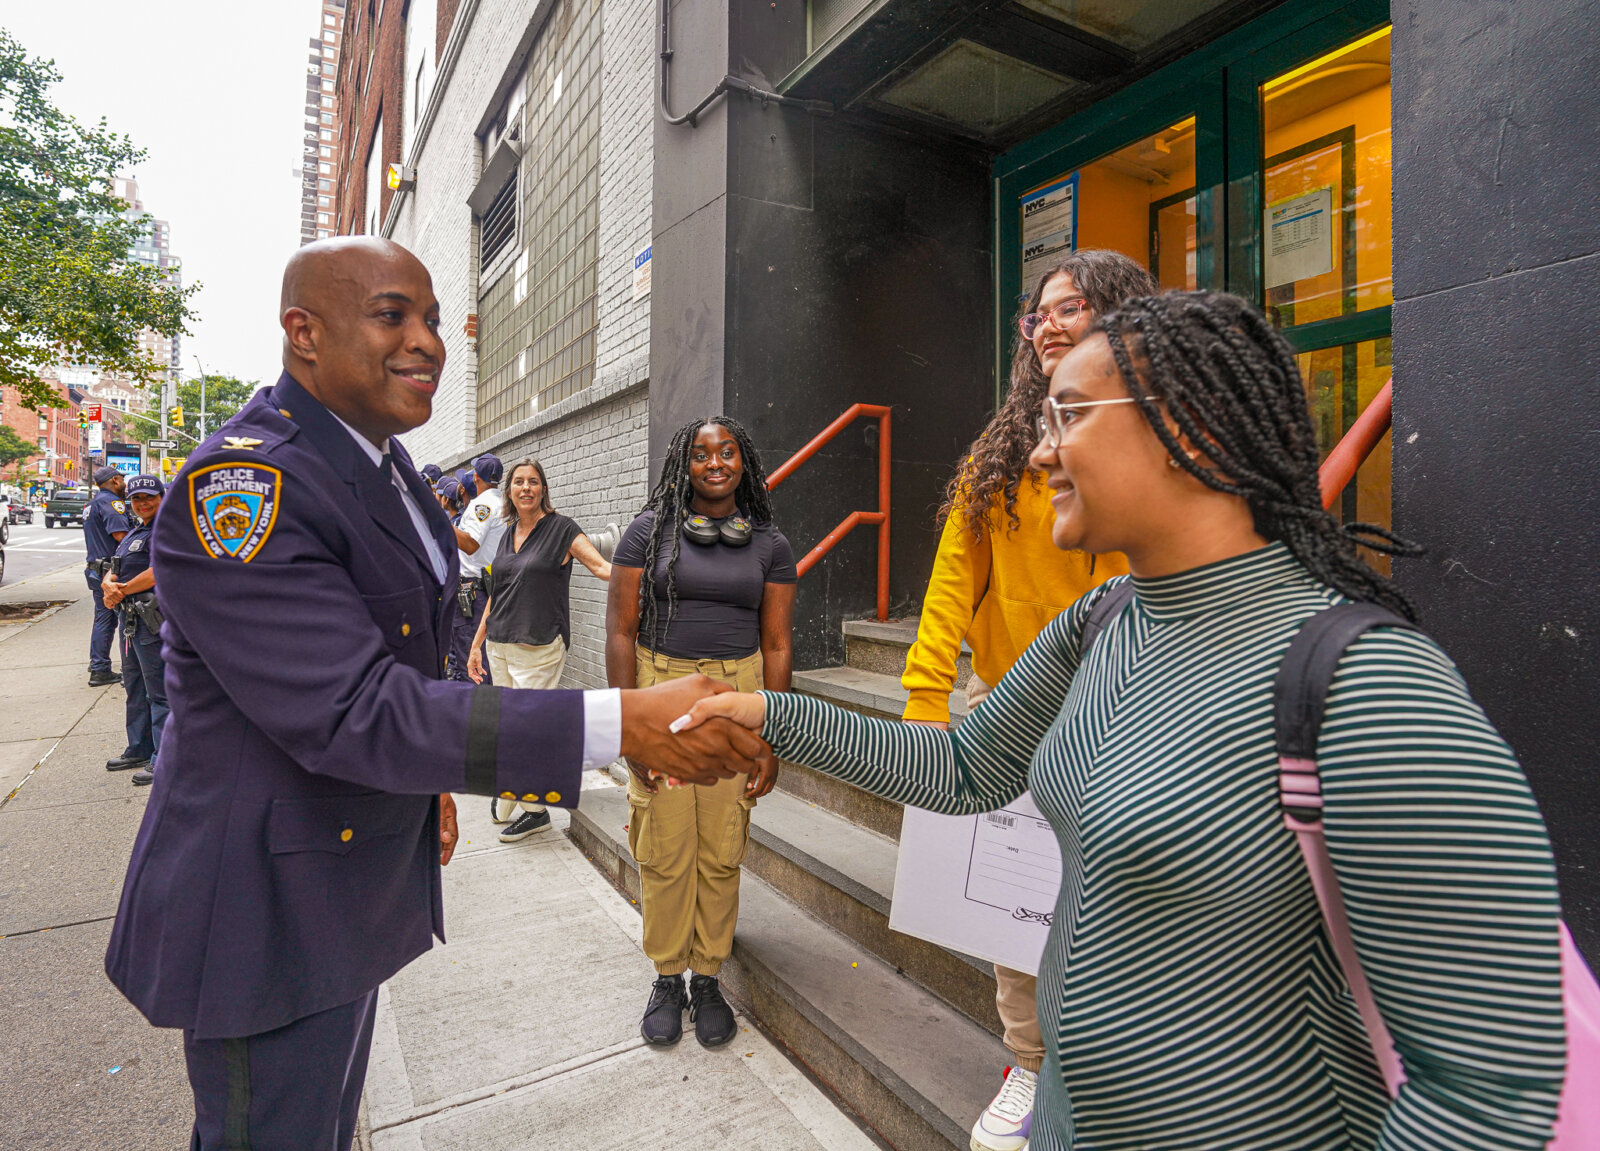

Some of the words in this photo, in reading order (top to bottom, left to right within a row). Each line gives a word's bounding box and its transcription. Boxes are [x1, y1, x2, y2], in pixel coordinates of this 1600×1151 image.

[1026, 198, 1045, 213] NYC
[636, 249, 652, 266] NOTI
[1025, 244, 1044, 257] NYC
[210, 468, 254, 483] POLICE
[129, 478, 156, 490] NYPD
[197, 479, 271, 501] DEPARTMENT
[197, 514, 213, 540] CITY
[209, 541, 225, 556] OF
[239, 534, 259, 559] NEW
[254, 502, 274, 534] YORK
